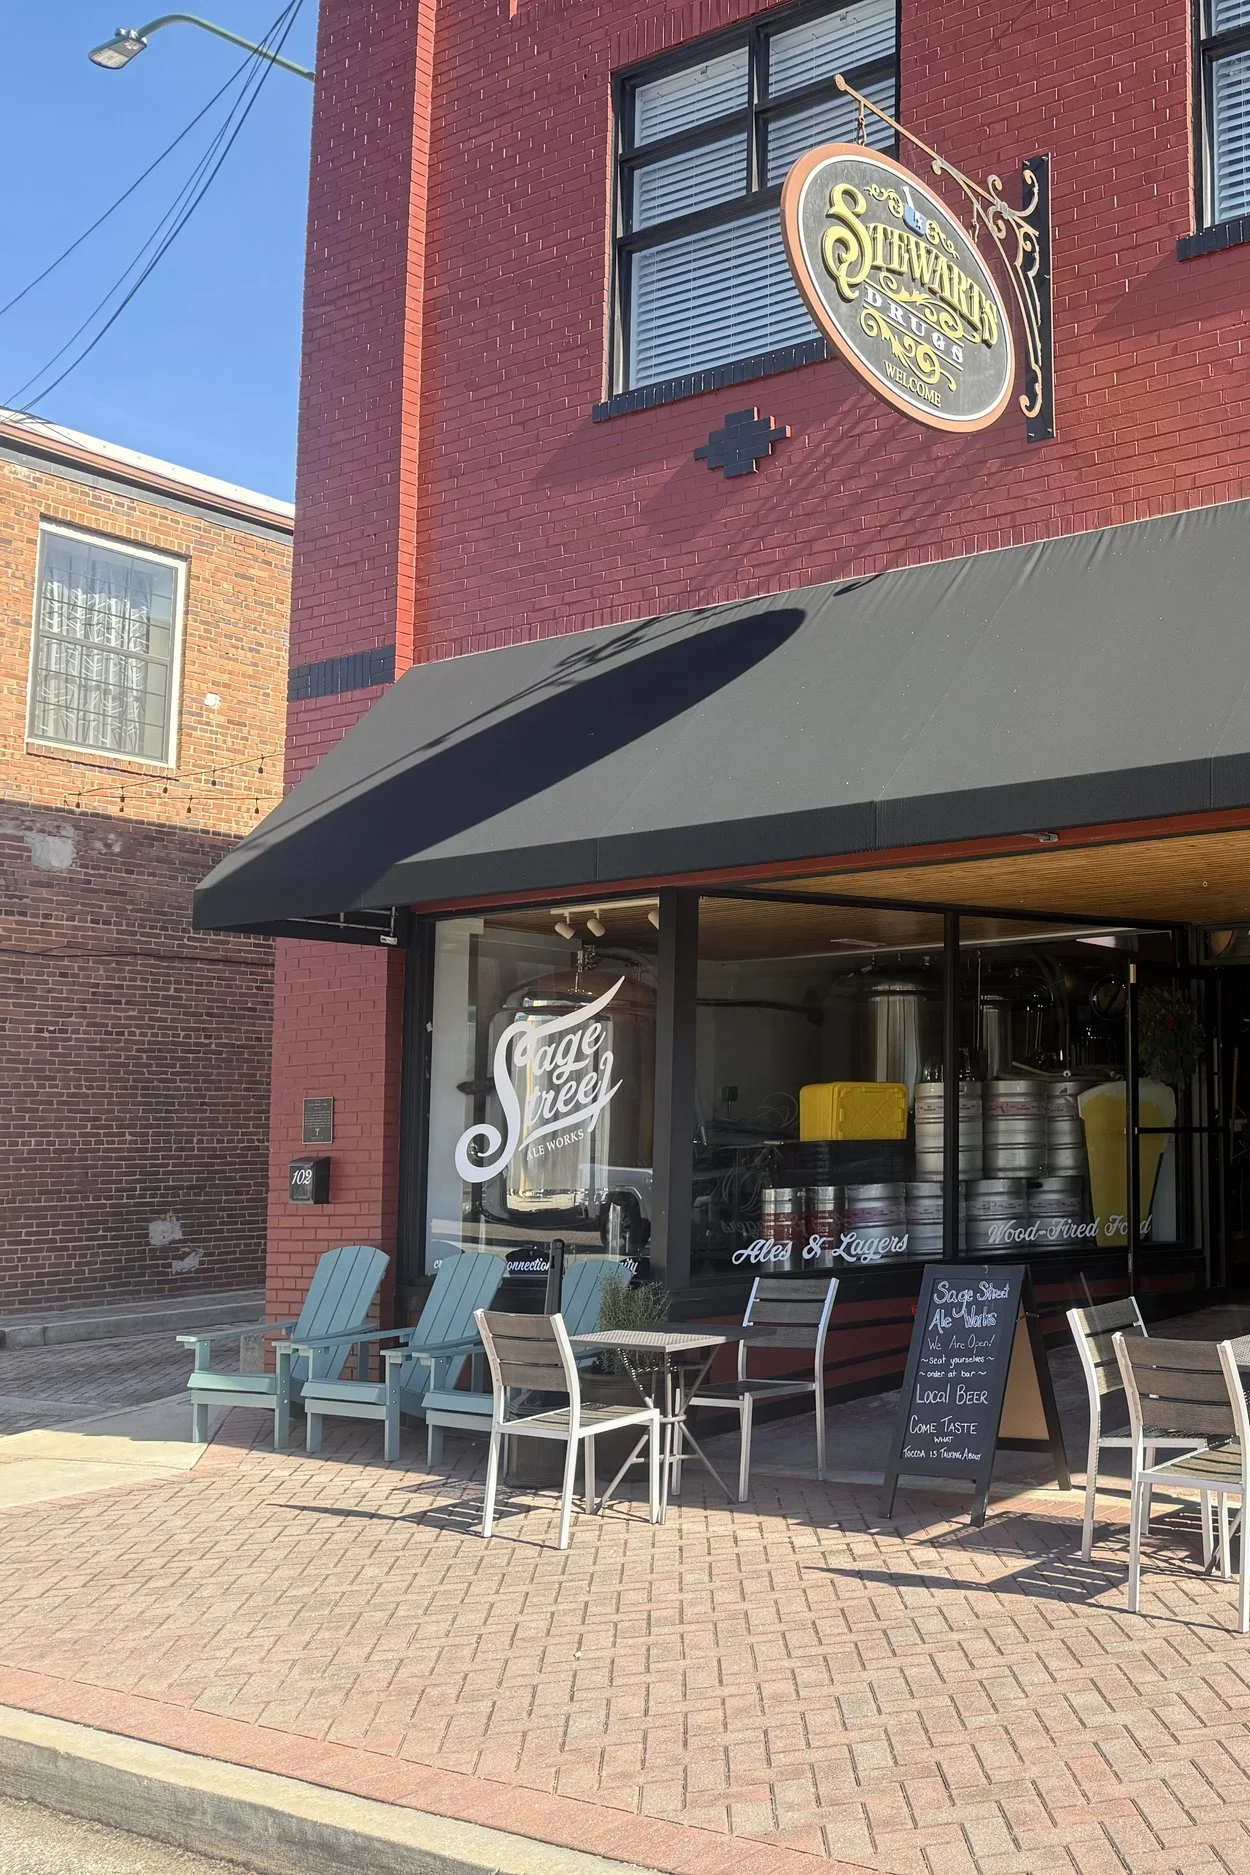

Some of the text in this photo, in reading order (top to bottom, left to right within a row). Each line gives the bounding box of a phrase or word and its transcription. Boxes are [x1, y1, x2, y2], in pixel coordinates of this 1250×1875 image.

[864, 286, 964, 364] DRUGS
[884, 360, 941, 408] WELCOME
[527, 1128, 584, 1160] ALE WORKS
[291, 1169, 312, 1185] 102
[988, 1214, 1152, 1244] Wood-Fired Fod
[732, 1232, 909, 1265] Ales & Lagers
[507, 1258, 550, 1271] onnectio
[934, 1281, 1010, 1318] Sage Street
[929, 1305, 997, 1334] Ale Works
[928, 1334, 996, 1353] We Are Open!
[948, 1369, 957, 1378] at
[956, 1384, 988, 1404] BEER
[910, 1414, 978, 1434] COME TASTE
